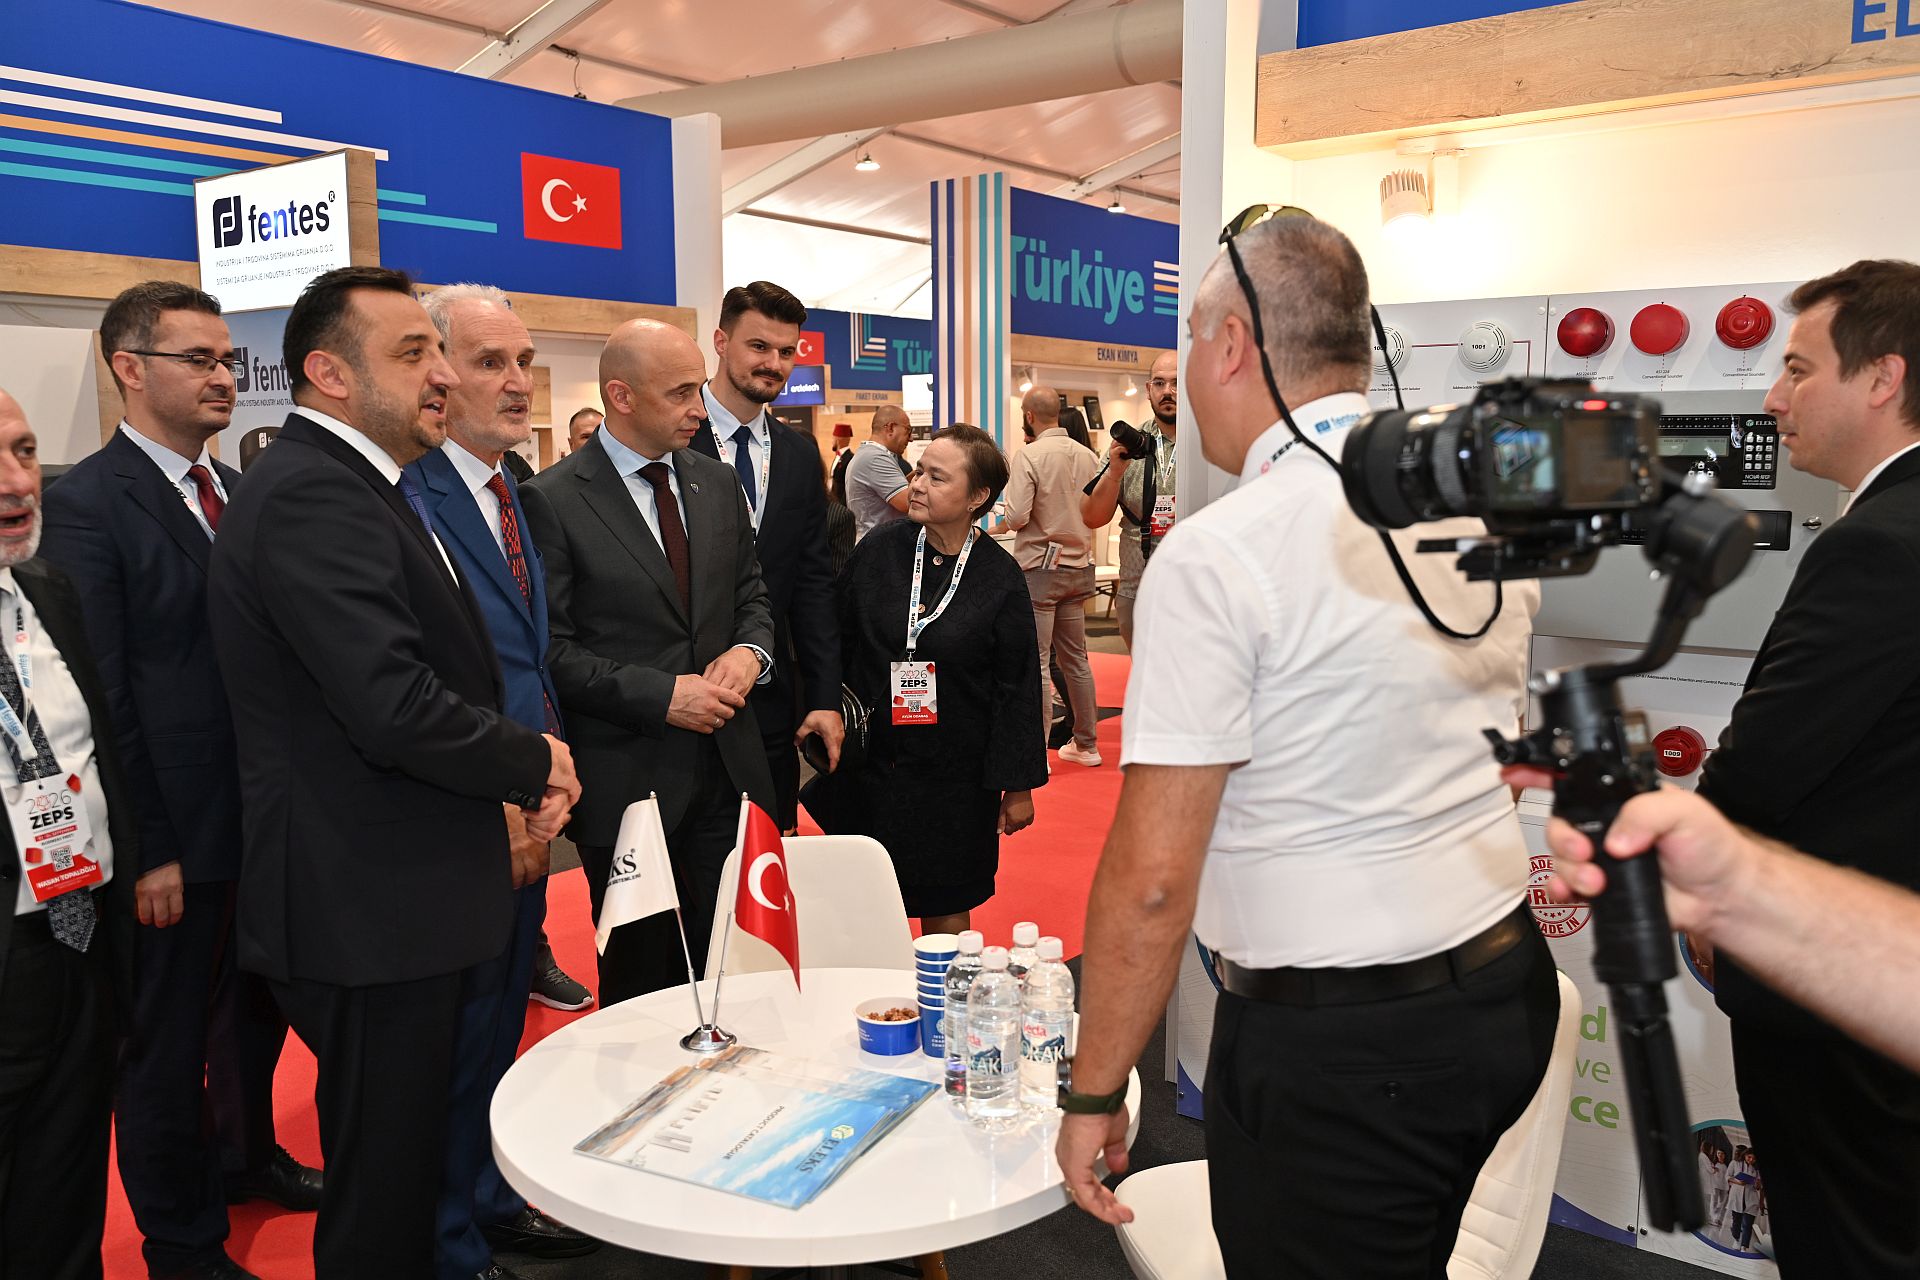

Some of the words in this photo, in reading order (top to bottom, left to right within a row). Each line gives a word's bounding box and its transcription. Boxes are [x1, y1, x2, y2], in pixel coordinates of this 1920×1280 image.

[1097, 348, 1115, 361] EKAN
[253, 356, 292, 392] fent
[901, 680, 928, 688] ZEPS
[2, 706, 23, 738] fentes
[30, 806, 74, 830] ZEPS
[800, 1137, 841, 1174] ELEKS
